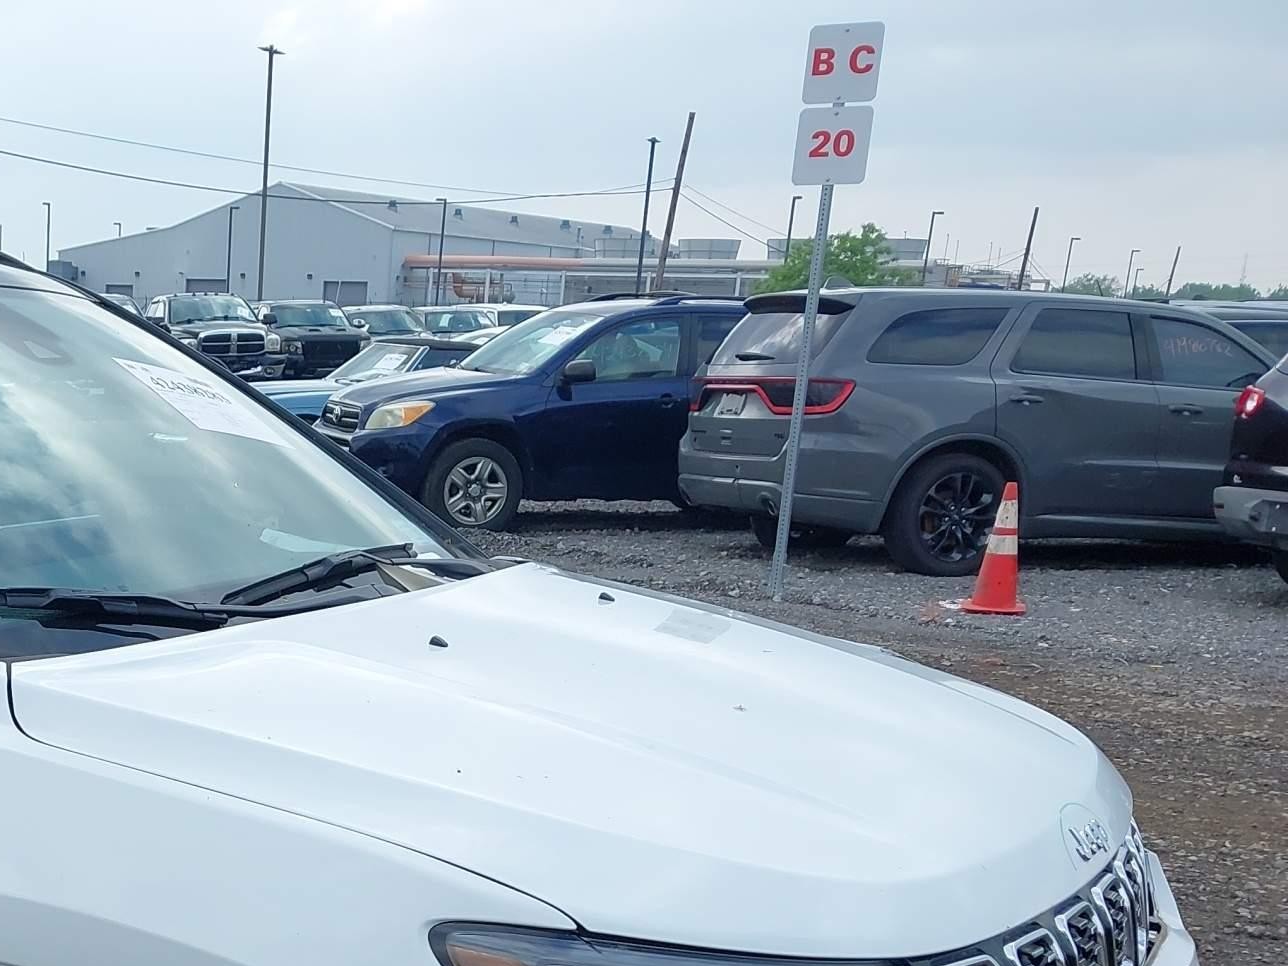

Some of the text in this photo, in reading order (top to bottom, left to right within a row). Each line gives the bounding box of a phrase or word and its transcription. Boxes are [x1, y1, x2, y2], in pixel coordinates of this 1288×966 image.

[811, 45, 875, 76] B C
[809, 130, 855, 157] 20
[1068, 820, 1110, 862] Jeep
